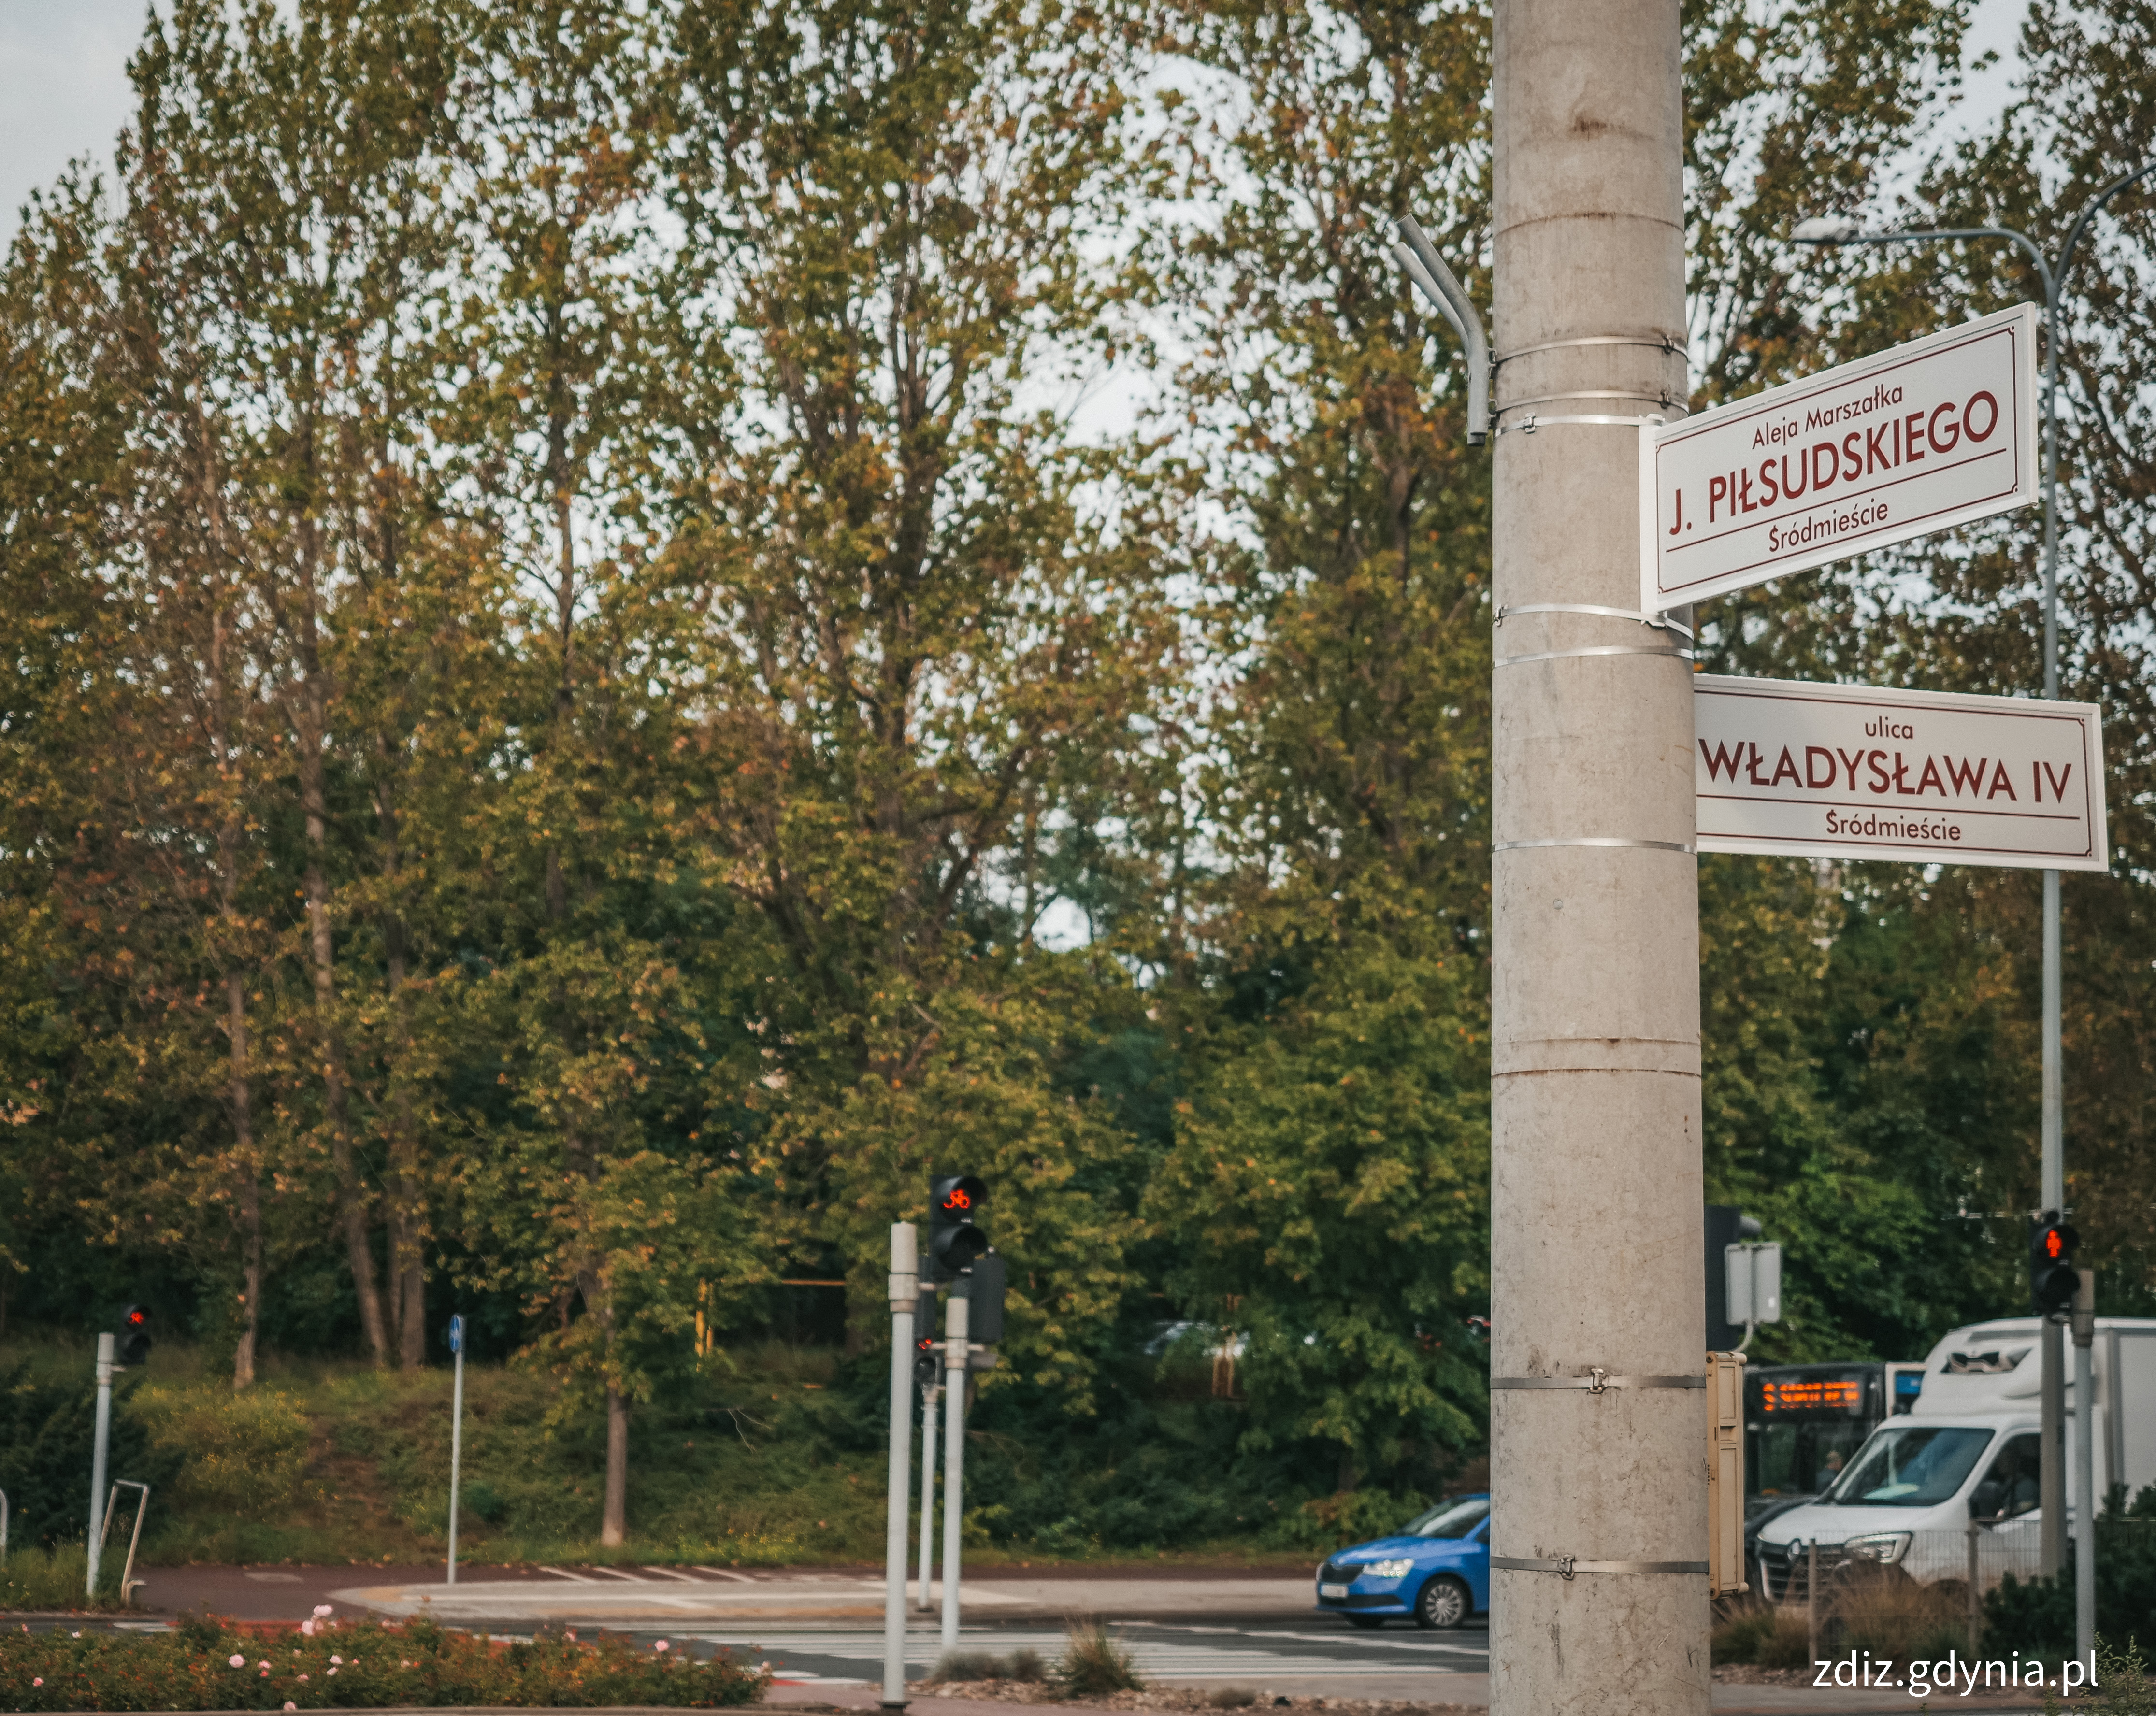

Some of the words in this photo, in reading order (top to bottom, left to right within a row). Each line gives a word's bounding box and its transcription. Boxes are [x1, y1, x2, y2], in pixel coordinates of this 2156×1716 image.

[1752, 416, 1798, 450] Aleja
[1805, 383, 1902, 432] Marszałka
[1669, 488, 1692, 535] J.
[1709, 390, 1998, 523] PIŁSUDSKIEGO
[1769, 498, 1888, 552] Śródmieście
[1865, 715, 1913, 740] ulica
[1697, 738, 2017, 801] WŁADYSŁAWA
[2032, 760, 2072, 804] IV
[1826, 809, 1961, 842] Śródmieście
